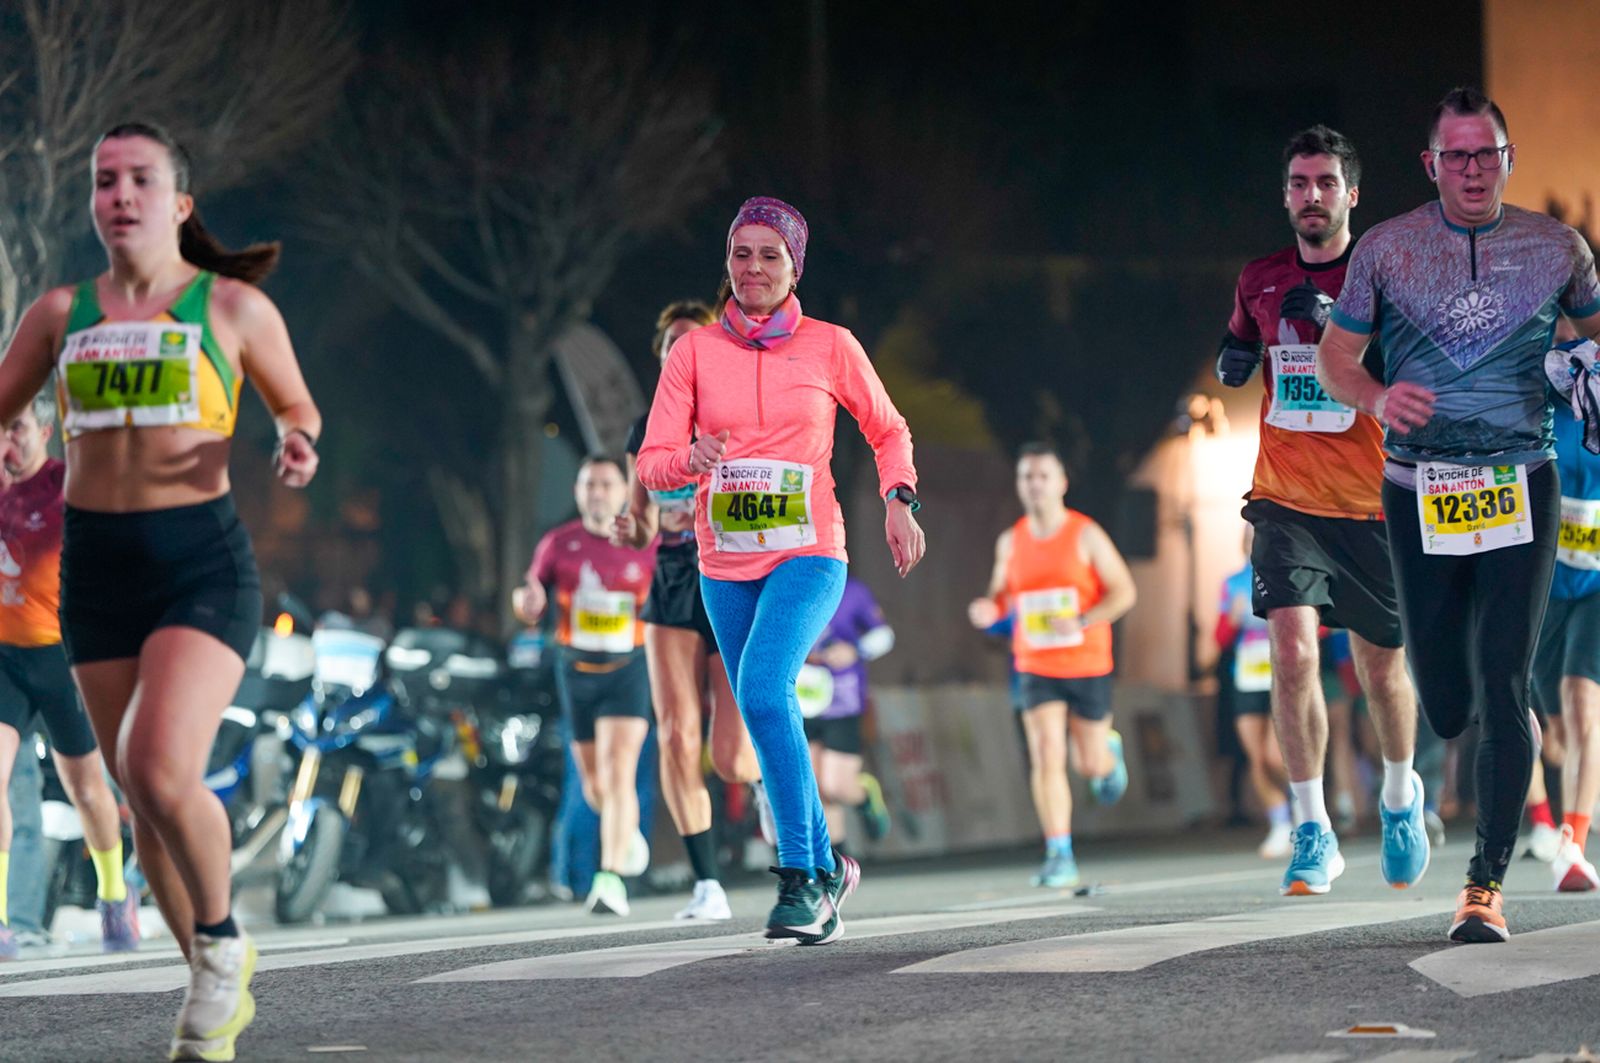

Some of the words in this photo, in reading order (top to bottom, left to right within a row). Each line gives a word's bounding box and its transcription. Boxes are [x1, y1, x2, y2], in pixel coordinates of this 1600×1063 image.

[1291, 354, 1312, 363] NOCHE
[1282, 364, 1296, 374] SAN
[93, 361, 162, 396] 7477
[1282, 375, 1337, 403] 1352
[730, 469, 757, 479] NOCHE
[760, 469, 772, 480] DE
[1438, 469, 1469, 481] NOCHE
[1471, 466, 1484, 477] DE
[721, 482, 737, 493] SAN
[1428, 482, 1449, 495] SAN
[727, 492, 788, 521] 4647
[1432, 487, 1516, 524] 12336
[1467, 522, 1486, 531] David
